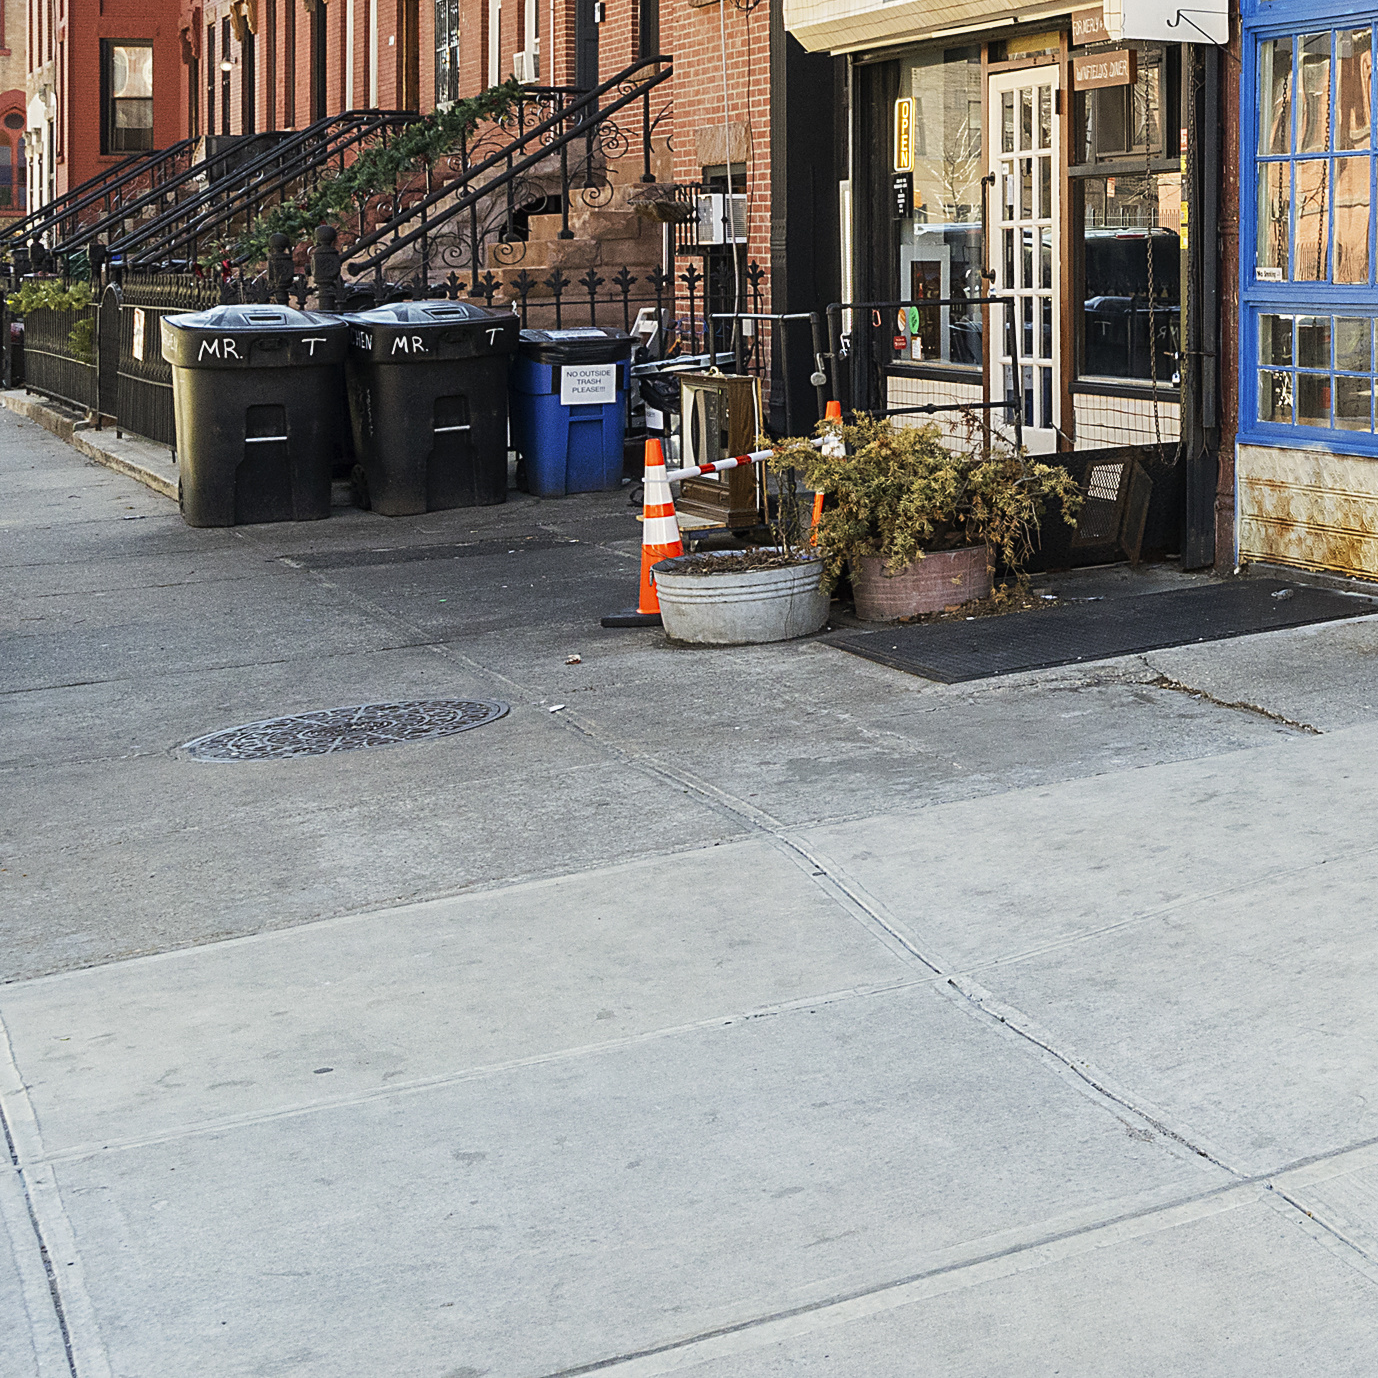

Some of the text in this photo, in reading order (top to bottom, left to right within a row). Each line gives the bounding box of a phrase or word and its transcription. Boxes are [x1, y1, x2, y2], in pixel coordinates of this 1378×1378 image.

[900, 102, 910, 168] OPEN
[197, 337, 244, 362] MR.
[301, 337, 327, 357] T
[391, 327, 505, 355] MR. T
[580, 369, 611, 378] OUTSIDE
[571, 386, 606, 394] PLEASE!!!
